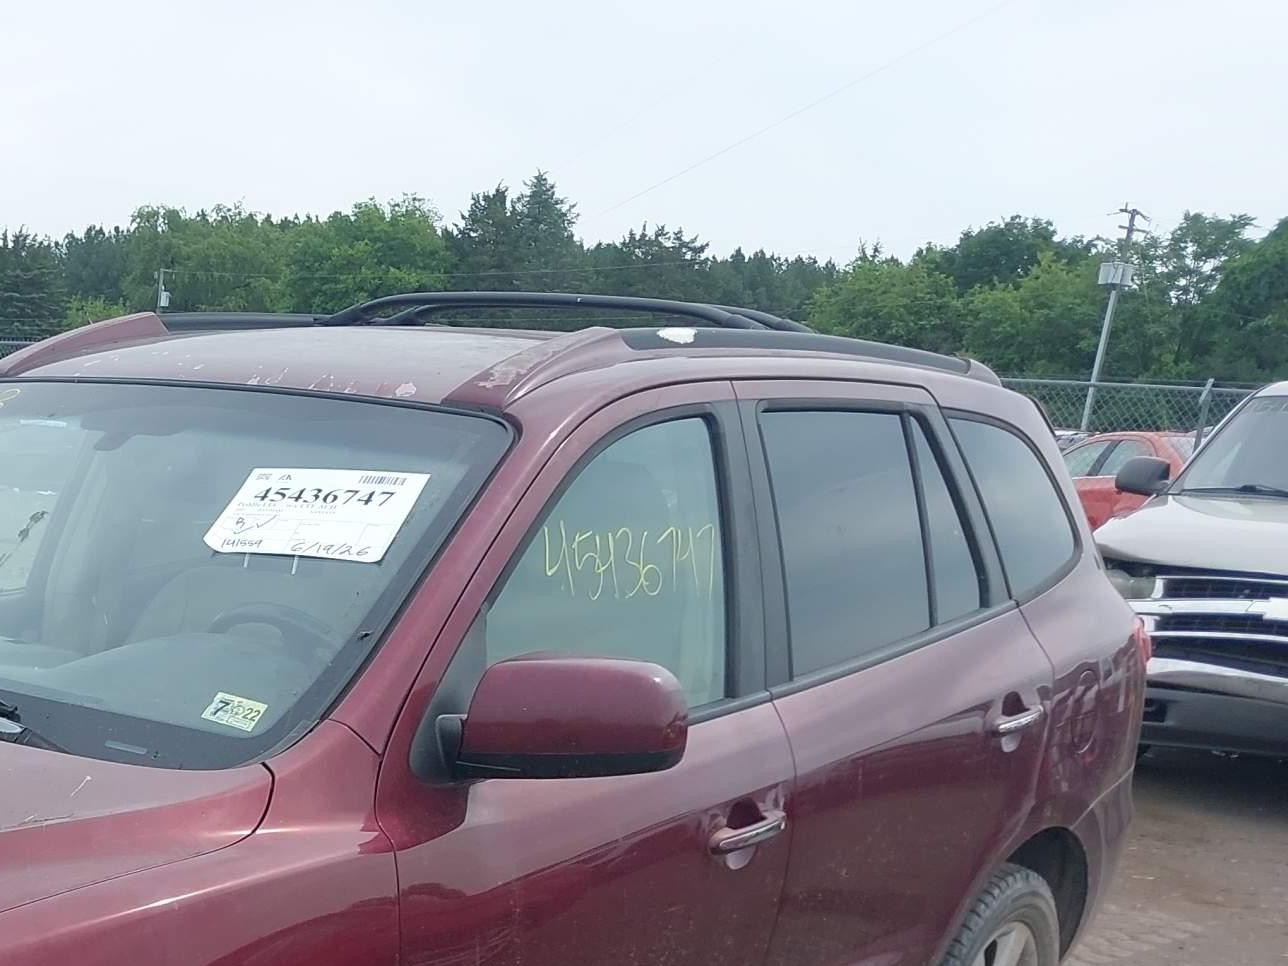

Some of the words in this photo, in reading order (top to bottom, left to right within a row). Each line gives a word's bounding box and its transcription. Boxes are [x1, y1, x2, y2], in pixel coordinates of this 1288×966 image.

[253, 486, 396, 507] 45436747
[290, 541, 371, 557] 6/19/26
[543, 519, 715, 600] 45436747
[213, 700, 231, 716] 7
[242, 707, 261, 722] 22
